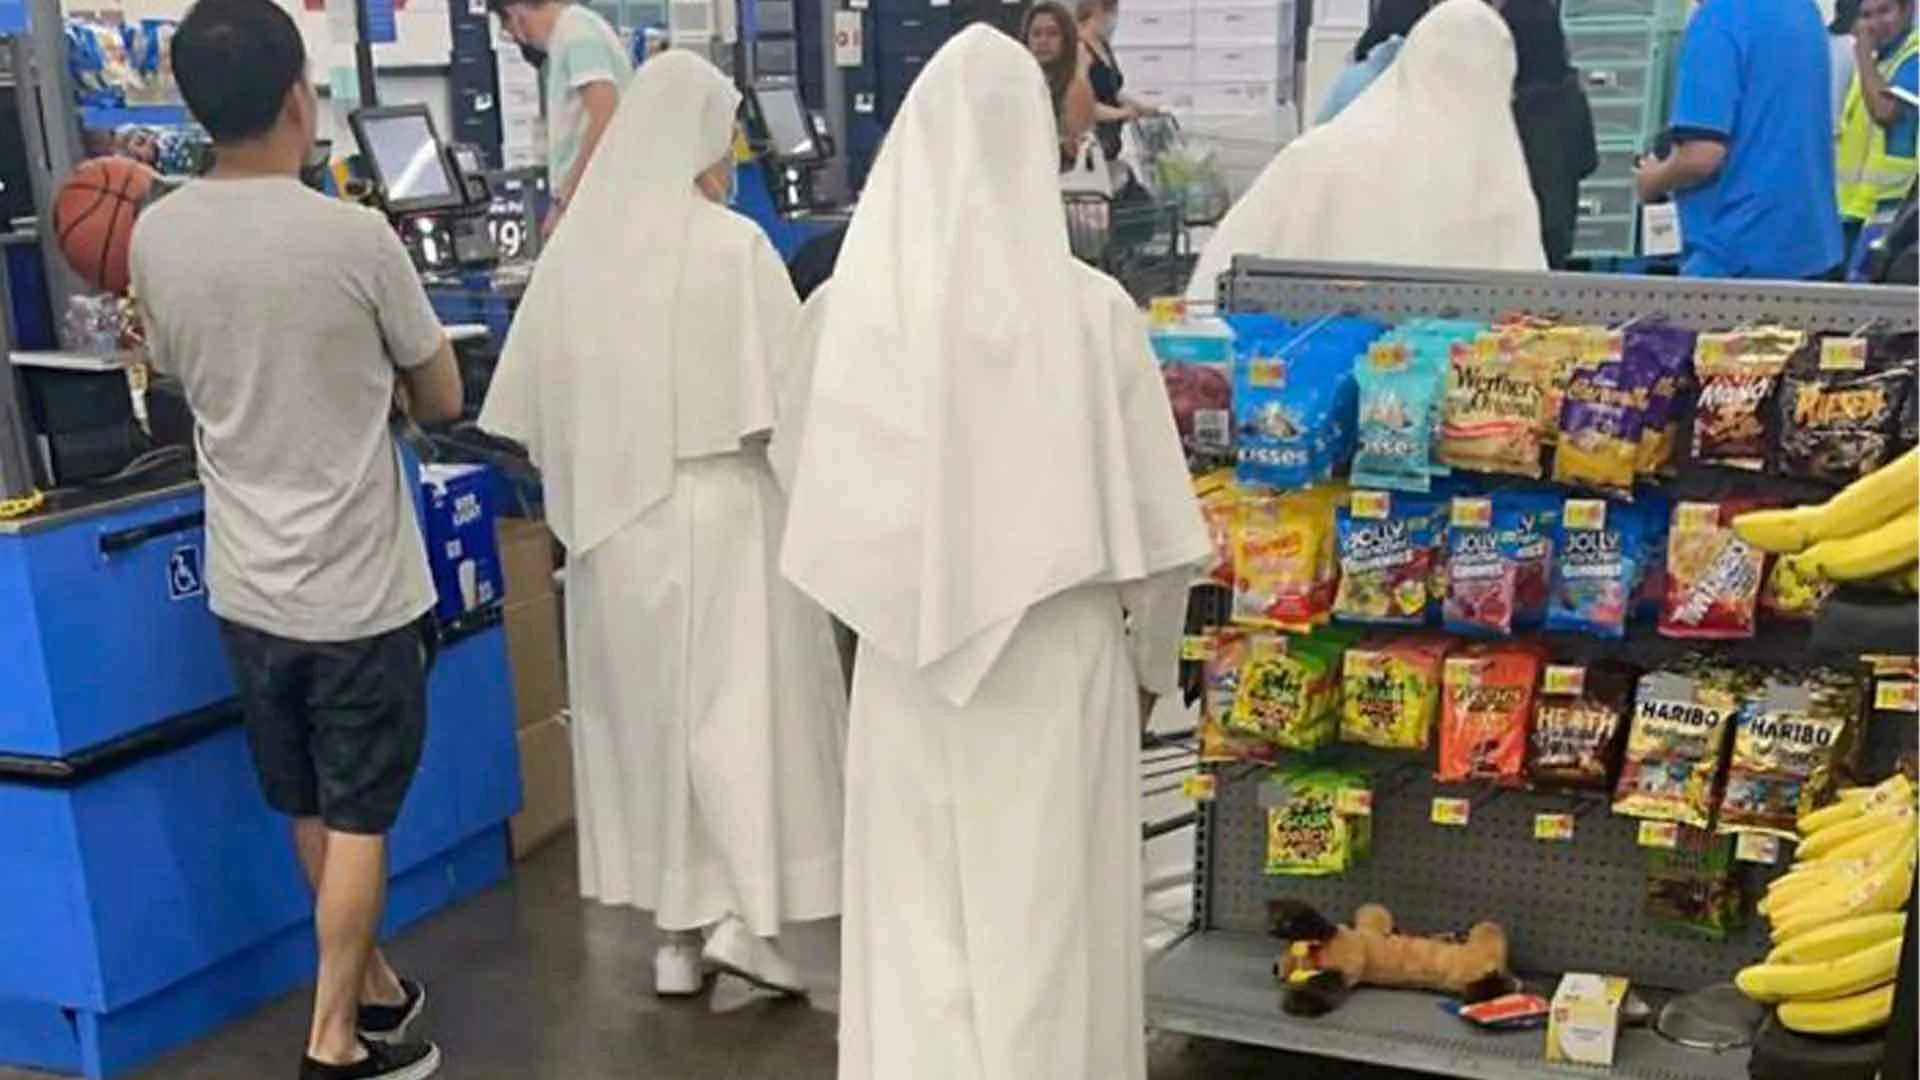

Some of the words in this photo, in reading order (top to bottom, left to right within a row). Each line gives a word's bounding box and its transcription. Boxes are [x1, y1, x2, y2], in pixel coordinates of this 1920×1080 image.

[1350, 519, 1405, 547] JOLLY
[1461, 533, 1497, 552] JOLLY
[1567, 532, 1620, 552] JOLLY
[1537, 704, 1618, 740] HEATH
[1641, 701, 1720, 728] HARIBO
[1750, 718, 1831, 746] HARIBO
